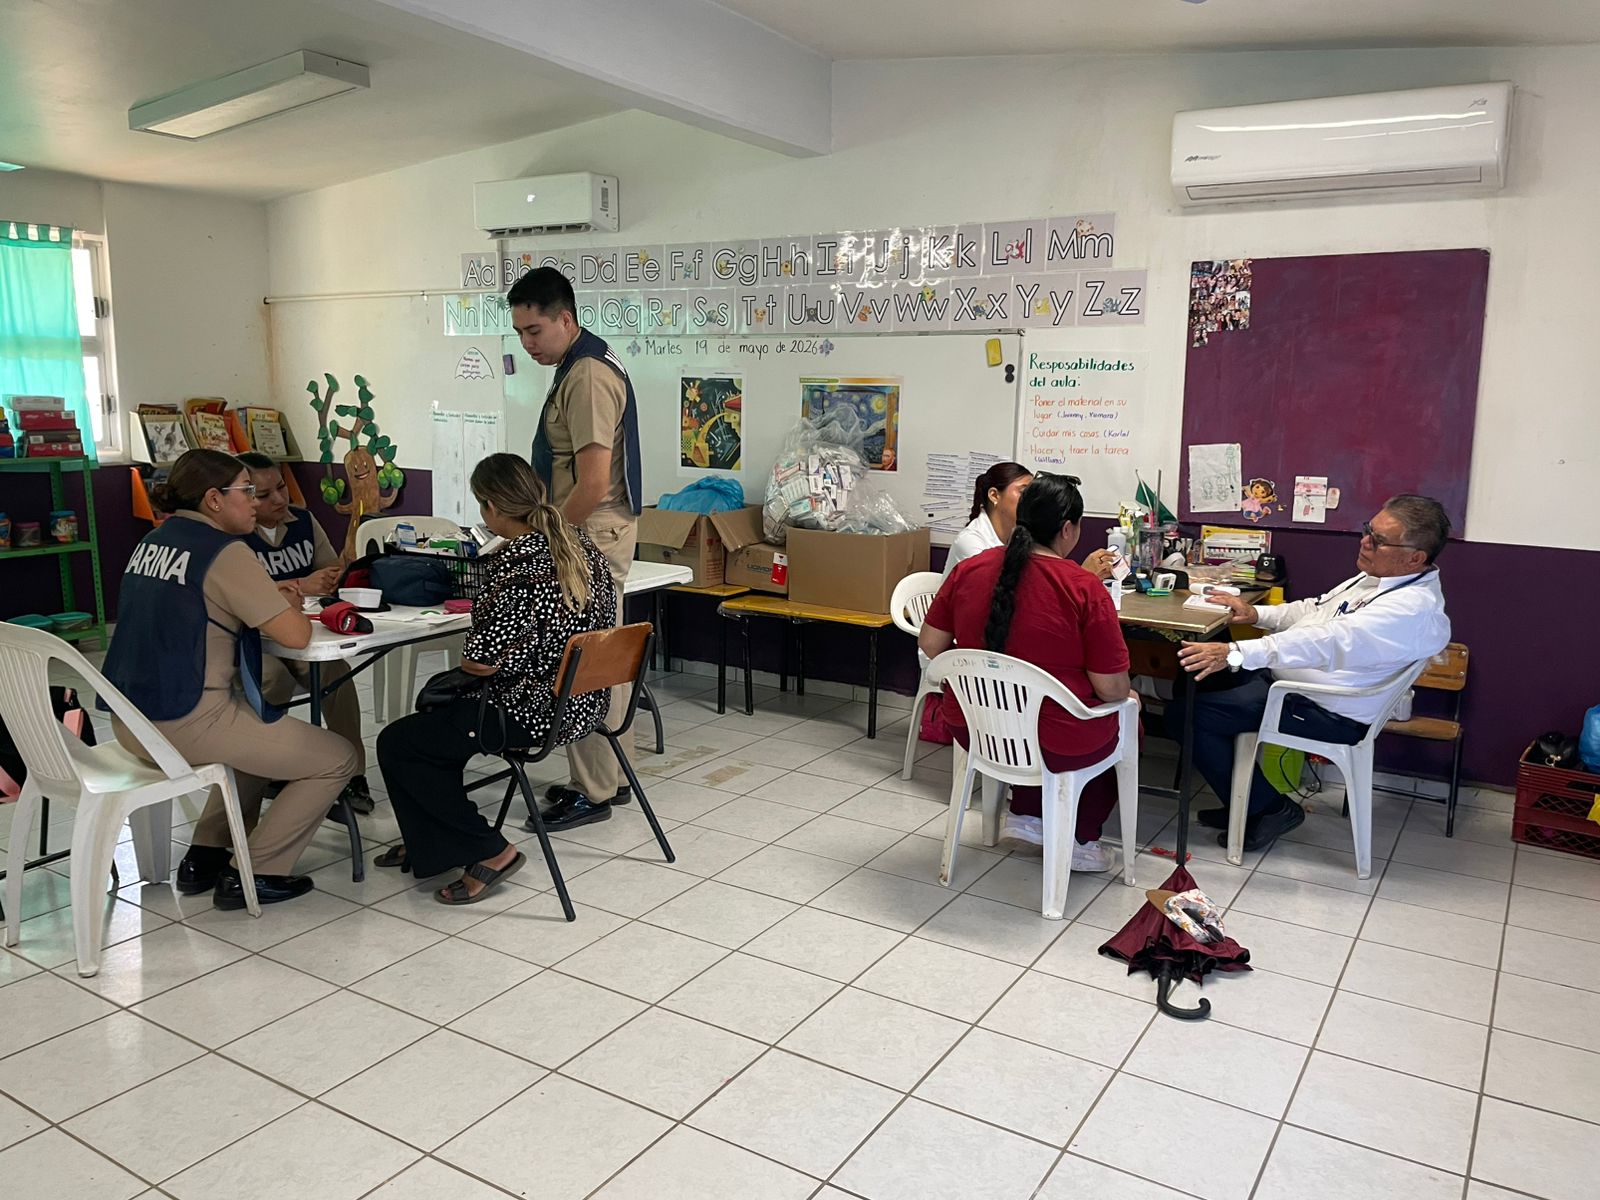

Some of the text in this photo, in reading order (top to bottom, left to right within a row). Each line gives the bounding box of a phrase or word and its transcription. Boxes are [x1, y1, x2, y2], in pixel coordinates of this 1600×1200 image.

[464, 260, 496, 286] Aa
[581, 253, 617, 283] Dd
[625, 253, 660, 282] Ee
[712, 249, 758, 285] Gg
[763, 245, 808, 277] Hh
[873, 236, 910, 279] Jj
[929, 233, 976, 269] Kk
[992, 228, 1033, 265] Ll
[1048, 229, 1113, 261] Mm
[446, 301, 478, 328] Nn
[579, 304, 596, 327] p
[601, 298, 641, 333] Qq
[648, 298, 682, 326] Rr
[693, 296, 728, 326] Ss
[742, 294, 776, 325] Tt
[788, 294, 834, 325] Uu
[840, 292, 890, 323] Vv
[893, 292, 949, 322] Ww
[954, 287, 1008, 321] Xx
[1016, 283, 1073, 325] Yy
[1083, 281, 1142, 316] Zz
[645, 338, 818, 360] Martes 19 de mayo de 2026
[1029, 352, 1135, 373] Resposabilidades
[1029, 375, 1081, 388] del aula:
[1058, 397, 1065, 407] el
[1068, 395, 1102, 407] material
[1104, 399, 1114, 407] en
[1116, 399, 1128, 407] su
[1033, 410, 1053, 424] lugar
[1062, 428, 1076, 438] mis
[1069, 444, 1088, 454] traer
[1091, 444, 1100, 454] la
[1104, 443, 1130, 455] tarea
[256, 539, 314, 575] ARINA
